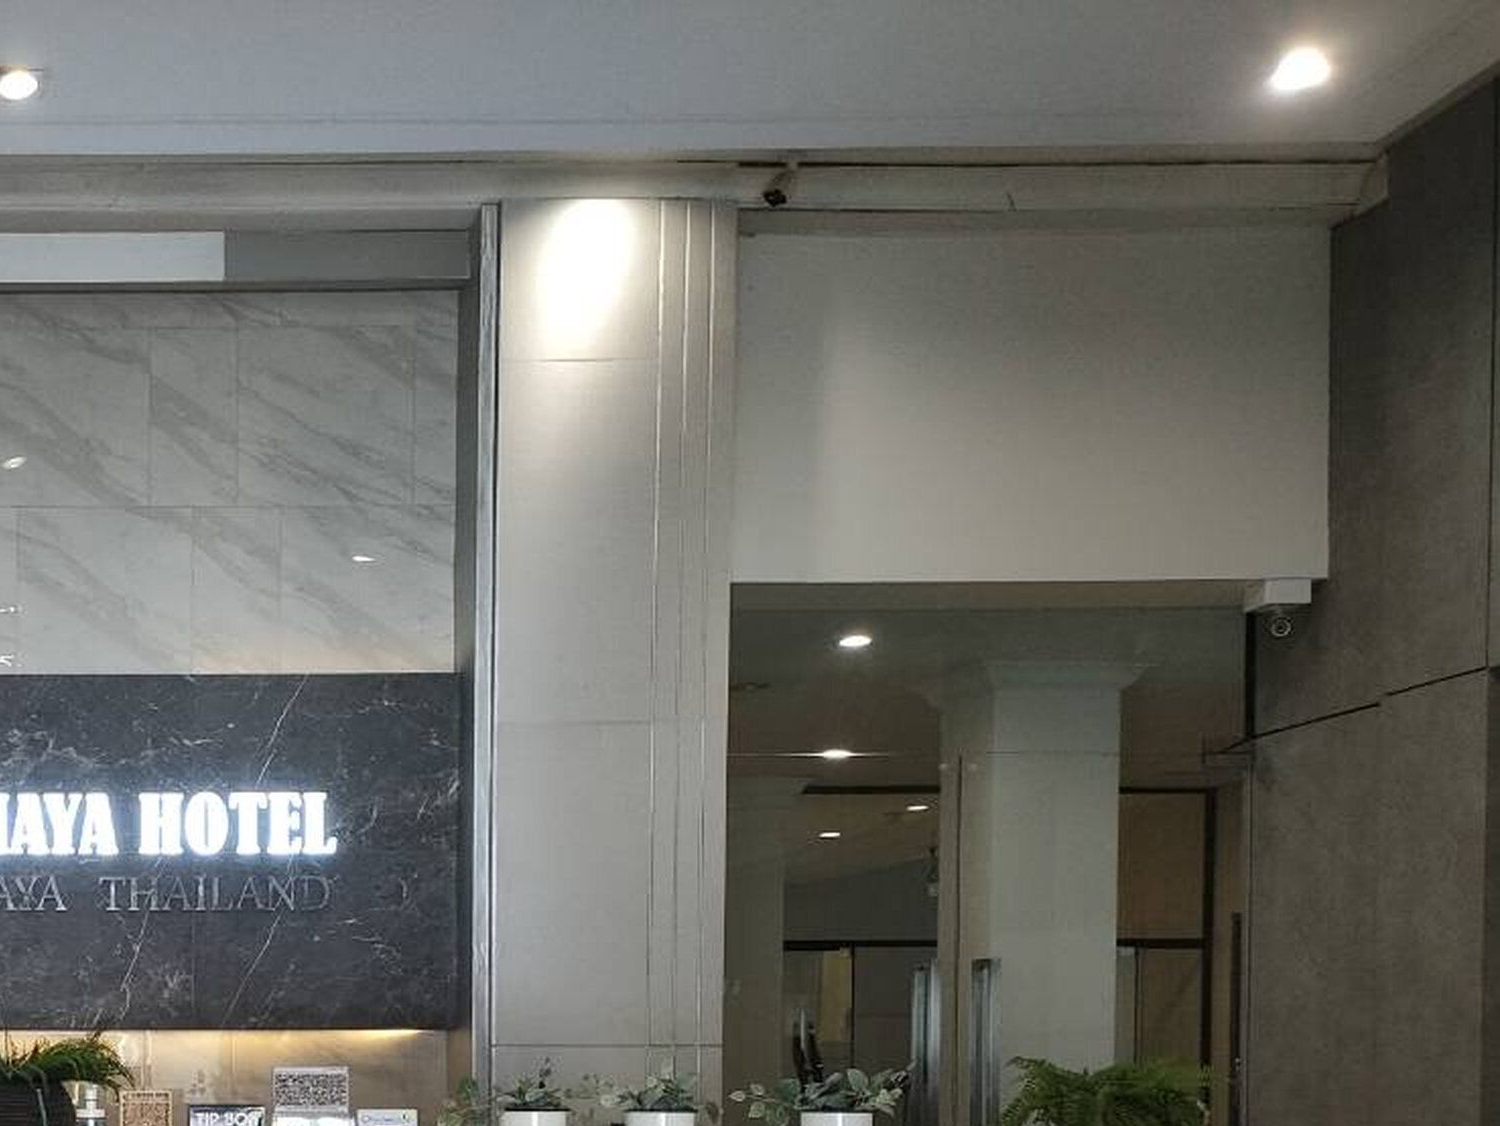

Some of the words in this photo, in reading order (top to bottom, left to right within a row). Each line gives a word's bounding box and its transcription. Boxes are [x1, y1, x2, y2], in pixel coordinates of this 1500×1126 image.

[137, 791, 336, 856] HOTEL
[100, 875, 334, 911] THAILAND
[195, 1112, 218, 1126] TIP
